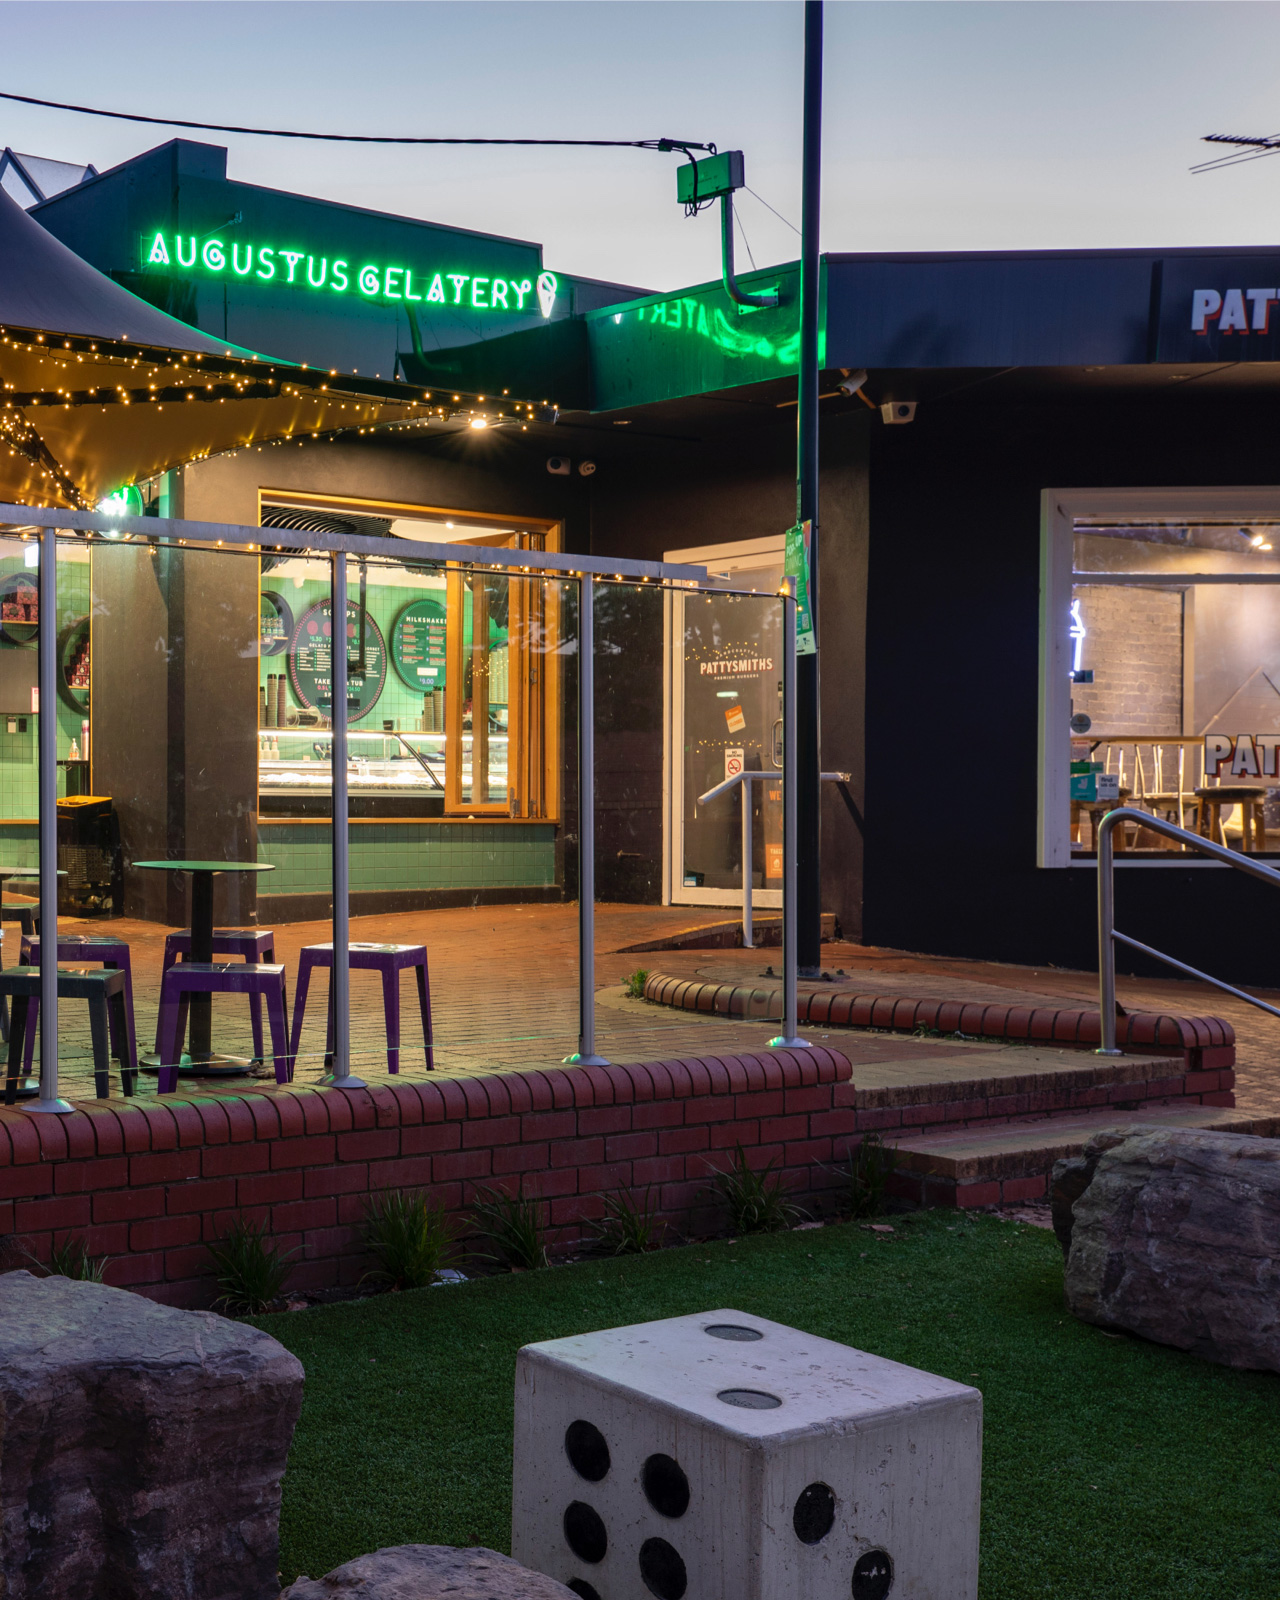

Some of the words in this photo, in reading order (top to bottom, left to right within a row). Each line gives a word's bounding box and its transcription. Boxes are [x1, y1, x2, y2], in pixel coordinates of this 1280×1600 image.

[147, 232, 348, 291] AUGUSTUS
[359, 265, 533, 310] GELATERY
[1191, 288, 1280, 335] PAT
[700, 658, 774, 675] PATTYSMITHS
